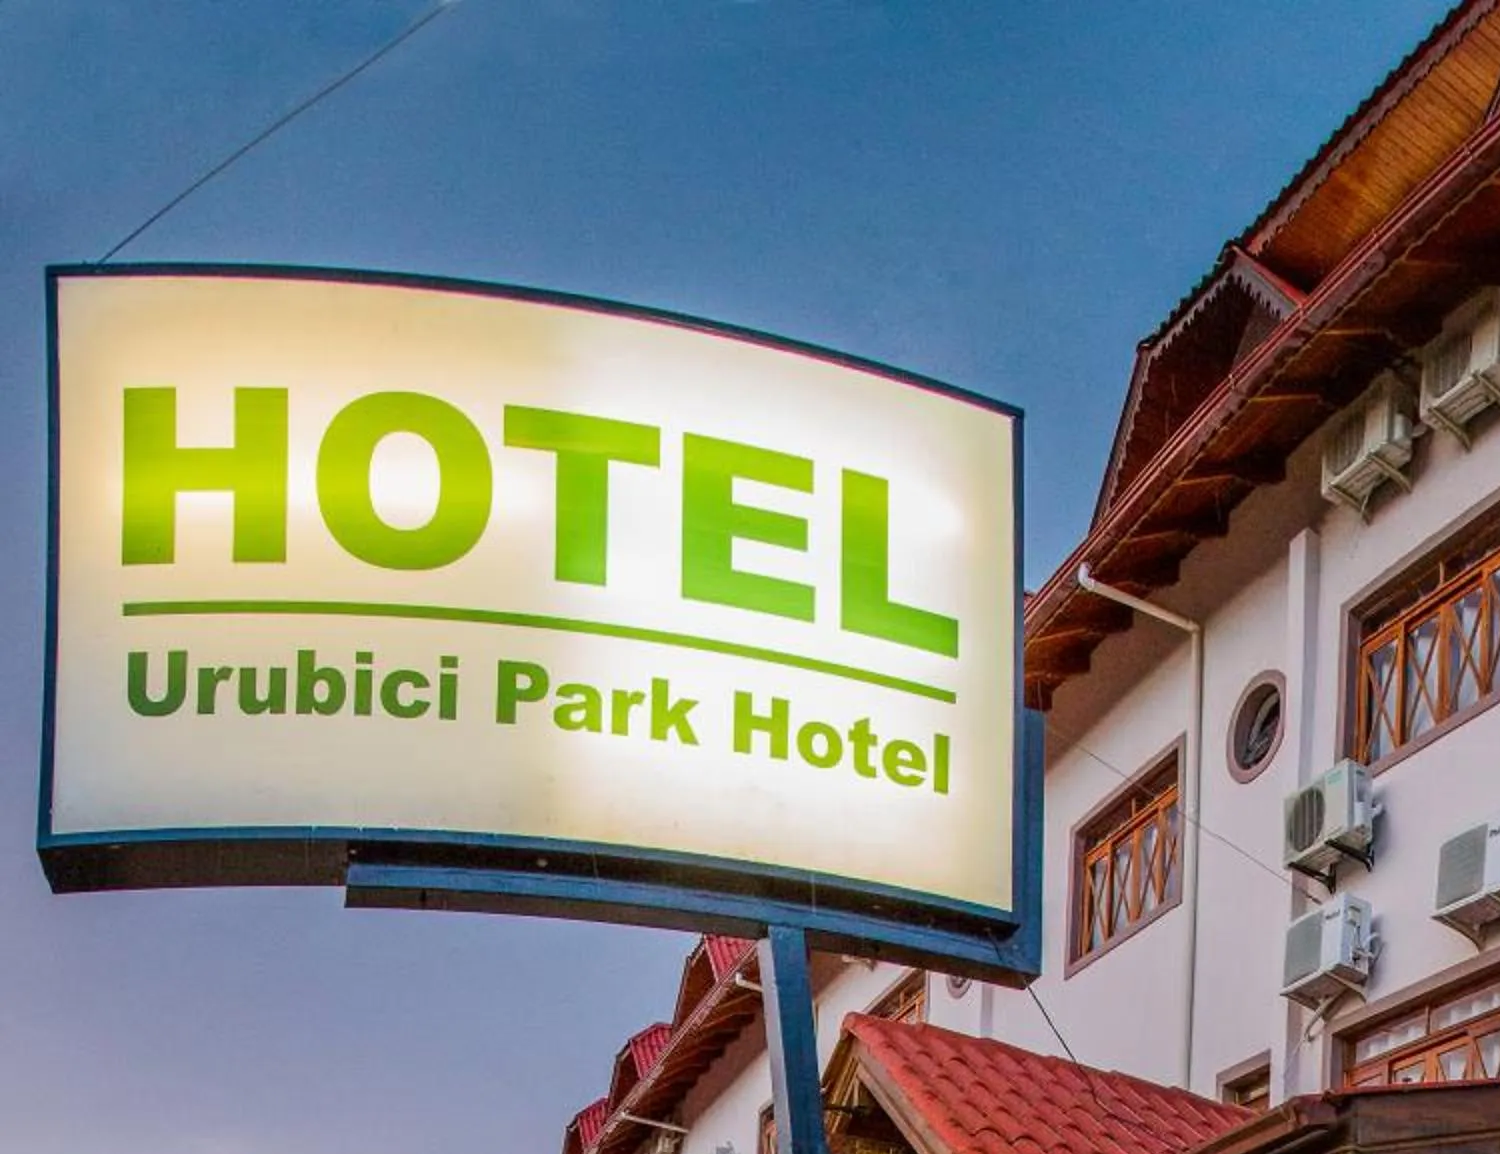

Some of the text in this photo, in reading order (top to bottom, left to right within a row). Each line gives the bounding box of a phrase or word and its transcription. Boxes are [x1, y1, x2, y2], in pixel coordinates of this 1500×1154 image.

[122, 387, 960, 659] HOTEL
[125, 650, 952, 795] Urubici Park Hotel
